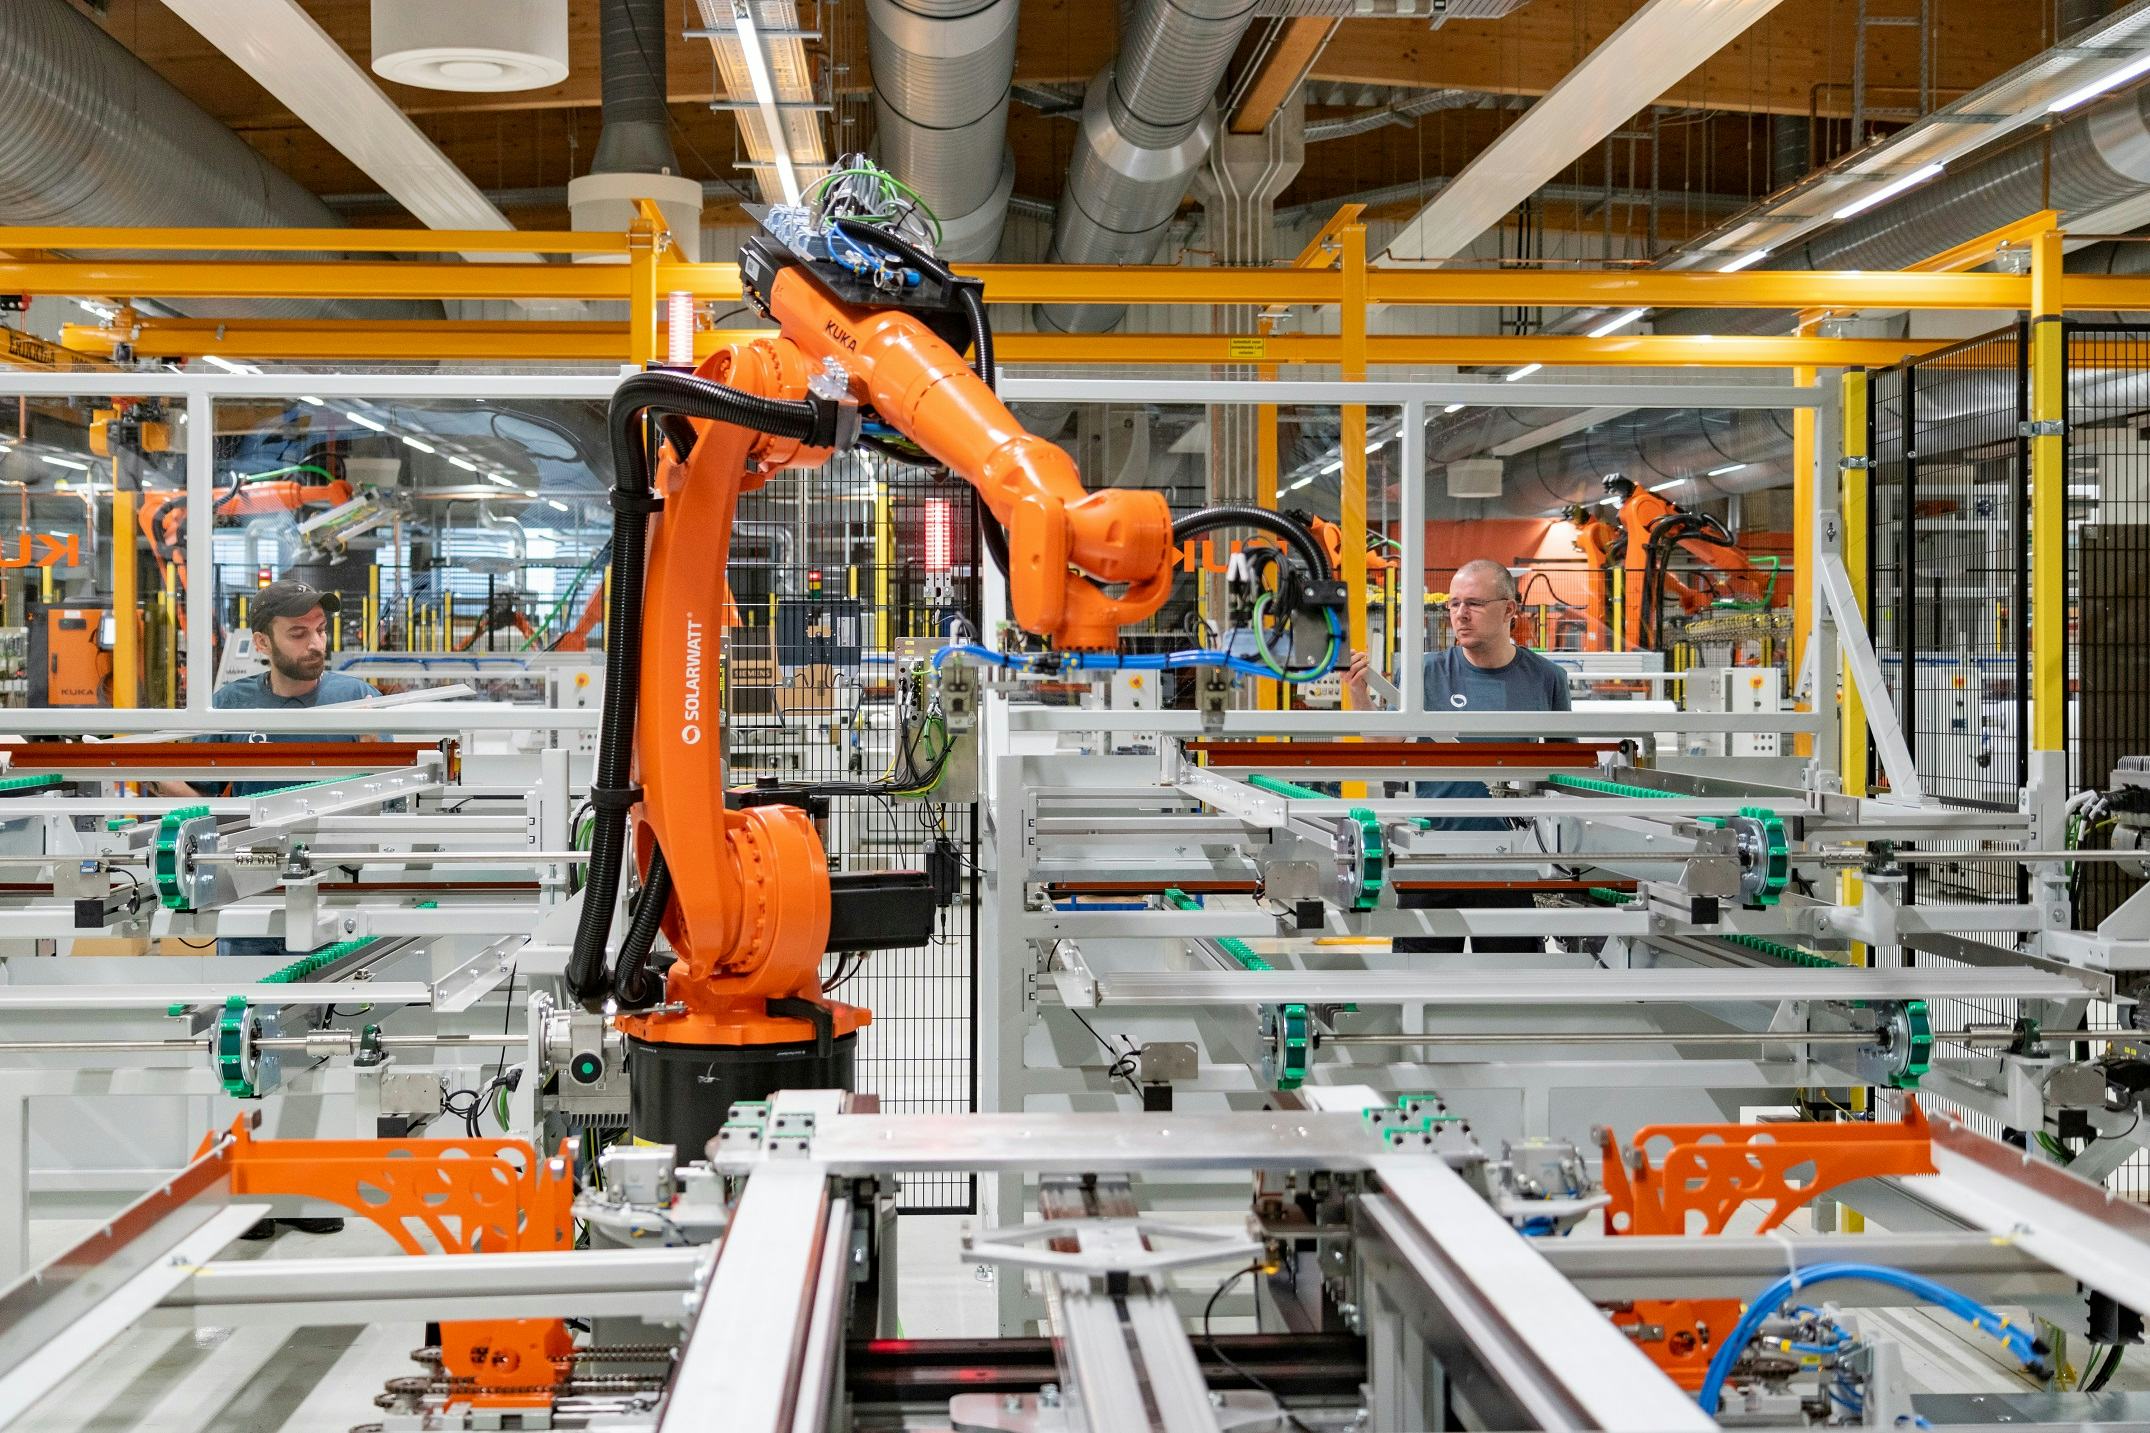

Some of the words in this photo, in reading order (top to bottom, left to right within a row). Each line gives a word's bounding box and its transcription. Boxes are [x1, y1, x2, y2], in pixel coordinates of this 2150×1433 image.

[825, 319, 857, 352] KUKA
[684, 619, 702, 721] SOLARWATT
[734, 669, 771, 678] SIEMENS
[61, 688, 94, 696] KUKA
